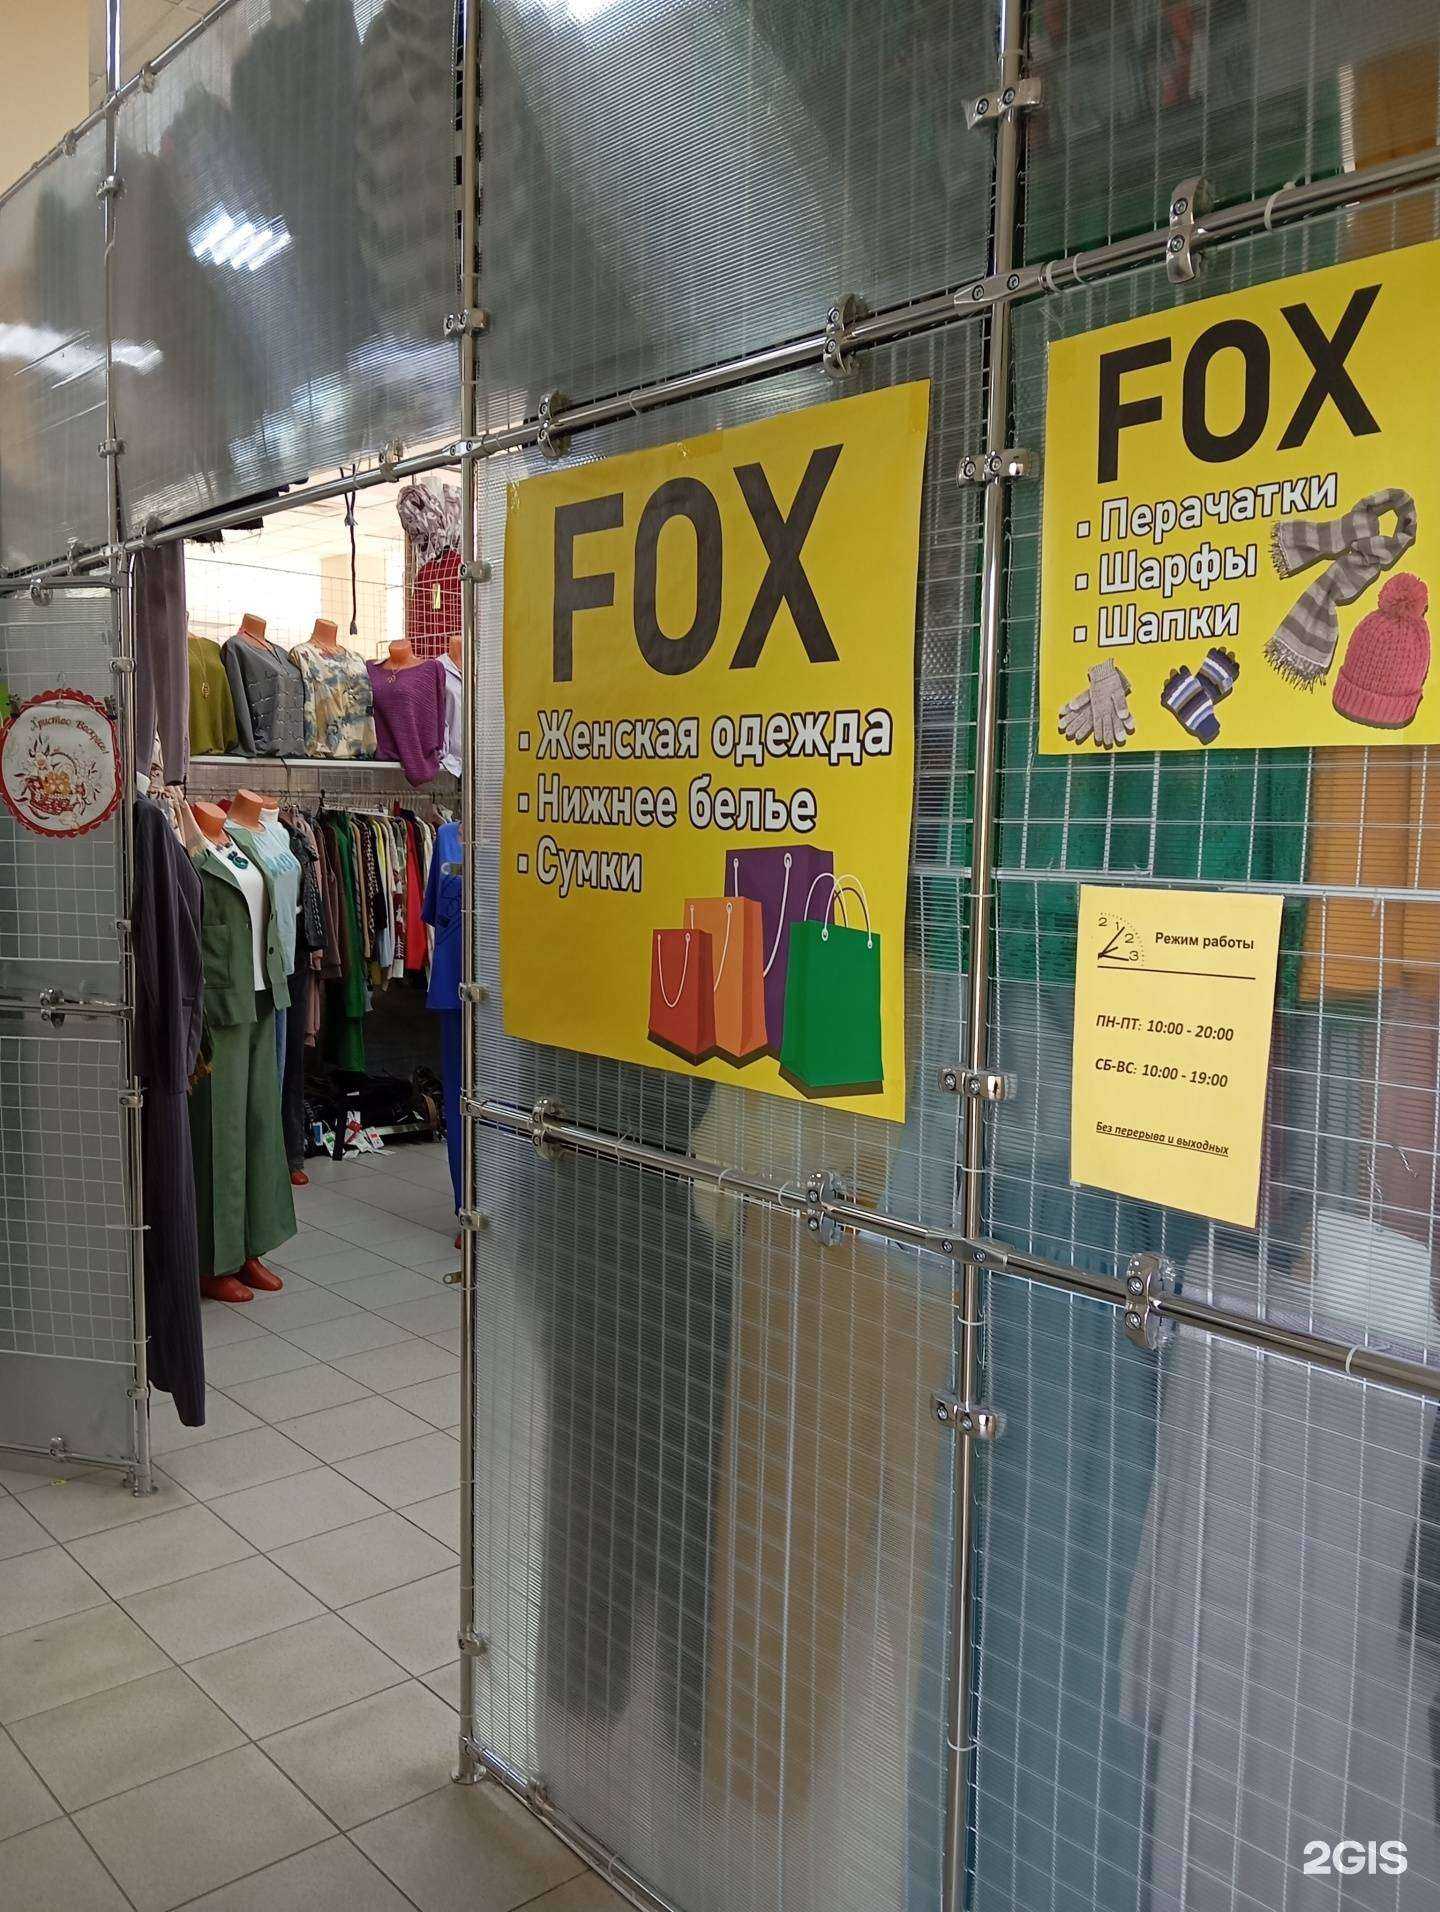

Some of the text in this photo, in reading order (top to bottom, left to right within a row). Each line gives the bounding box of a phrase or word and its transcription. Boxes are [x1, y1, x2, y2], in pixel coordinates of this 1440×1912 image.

[1098, 283, 1383, 484] FOX
[1100, 472, 1338, 544] Перачатки
[552, 443, 844, 683] FOX
[1099, 543, 1257, 598] Шарфы
[1098, 602, 1240, 647] Шапки
[536, 707, 892, 766] Женская одежда
[536, 773, 817, 832] Нижнее белье
[535, 835, 642, 897] Сумки
[1155, 931, 1254, 950] Режим работы
[1096, 1014, 1142, 1031] ПН-ПТ:
[1146, 1019, 1183, 1036] 10:00
[1195, 1025, 1234, 1041] 20:00
[1095, 1058, 1137, 1075] СБ-ВС:
[1142, 1064, 1179, 1080] 10:00
[1189, 1071, 1228, 1088] 19:00
[1096, 1121, 1229, 1155] Без перерыва и выходных
